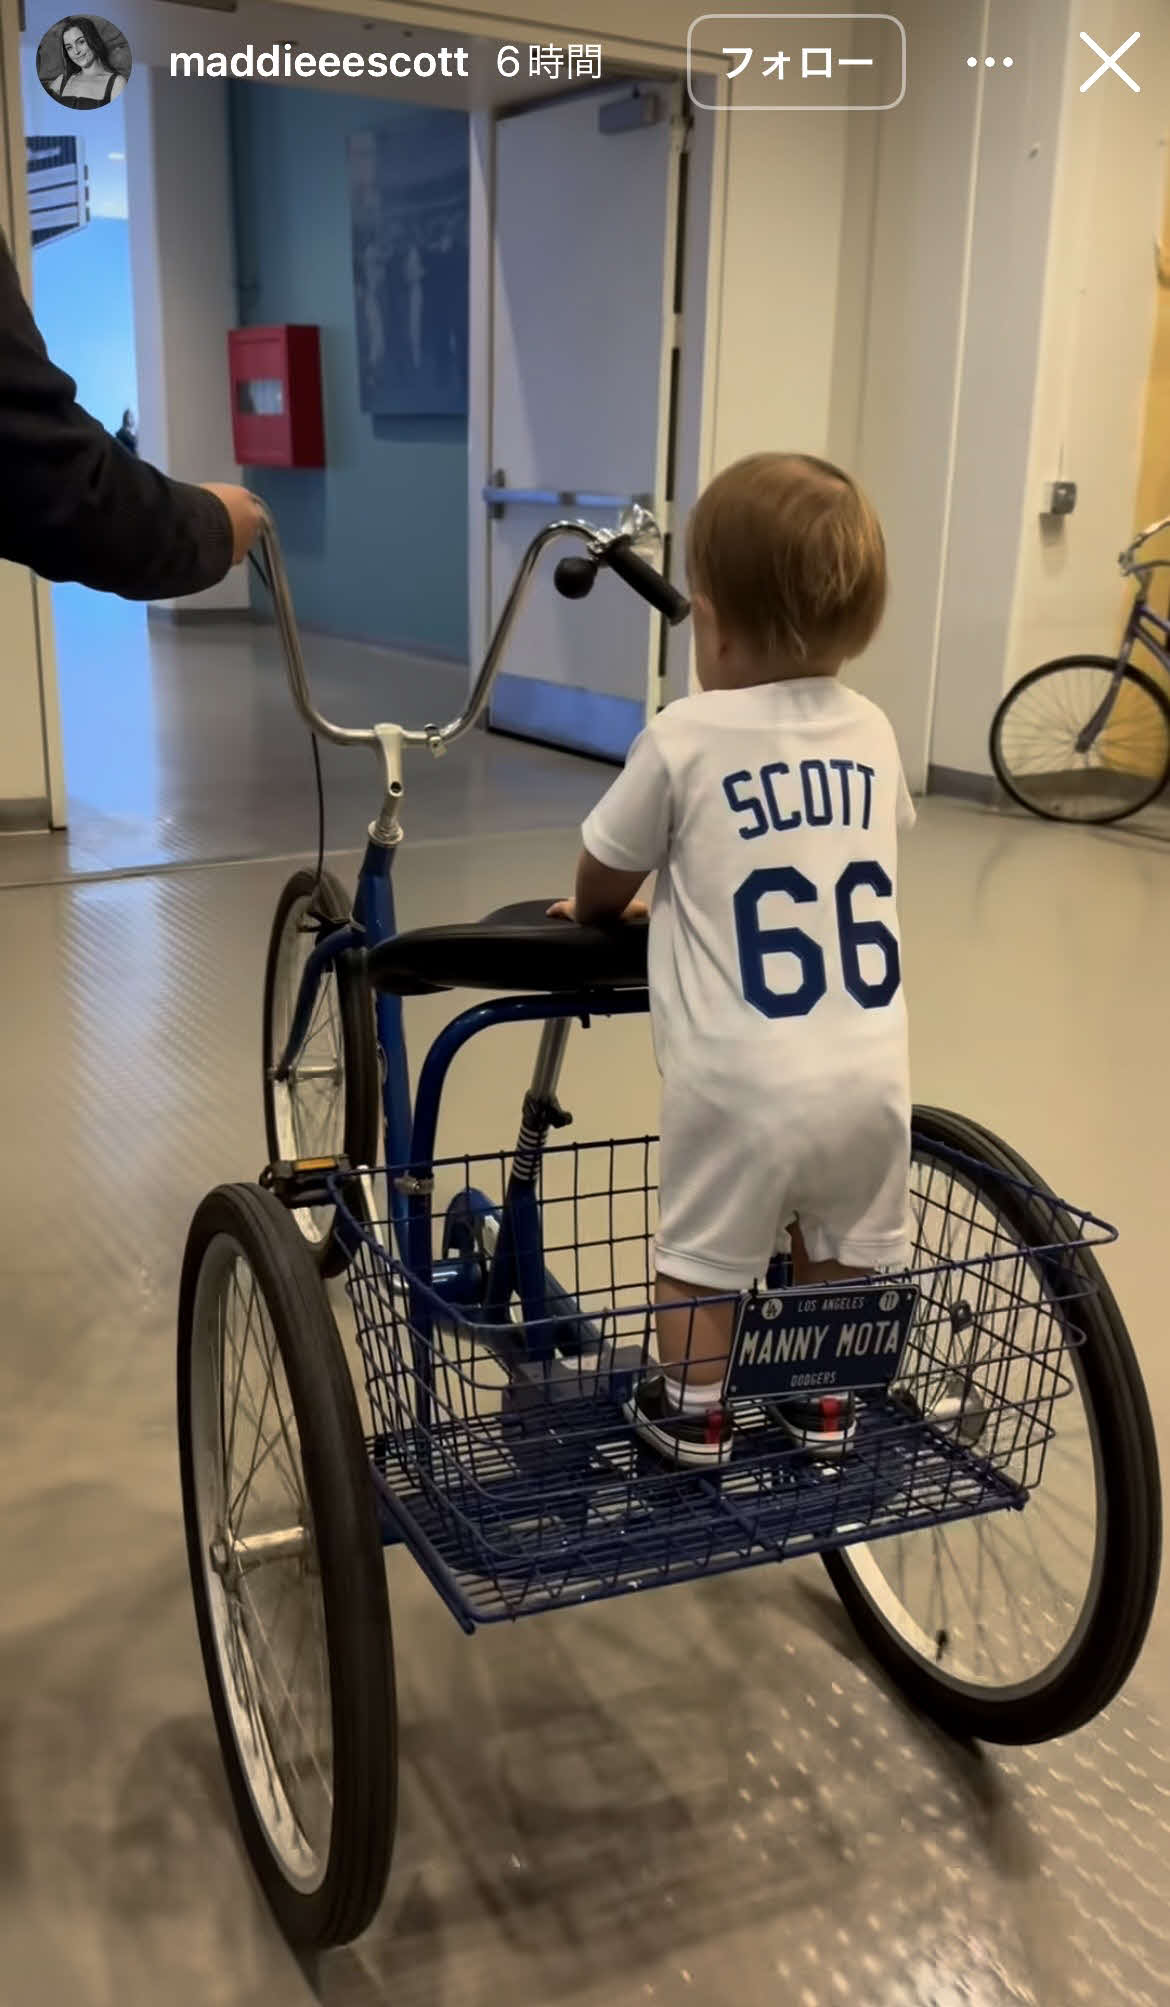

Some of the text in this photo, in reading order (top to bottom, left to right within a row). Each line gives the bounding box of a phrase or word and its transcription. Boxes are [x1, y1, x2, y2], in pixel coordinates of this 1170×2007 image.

[722, 759, 875, 840] SCOTT
[733, 861, 901, 1019] 66
[798, 1297, 865, 1313] LOS ANGELES
[738, 1319, 900, 1367] MANNY MOTA
[790, 1370, 836, 1387] DODGERS
